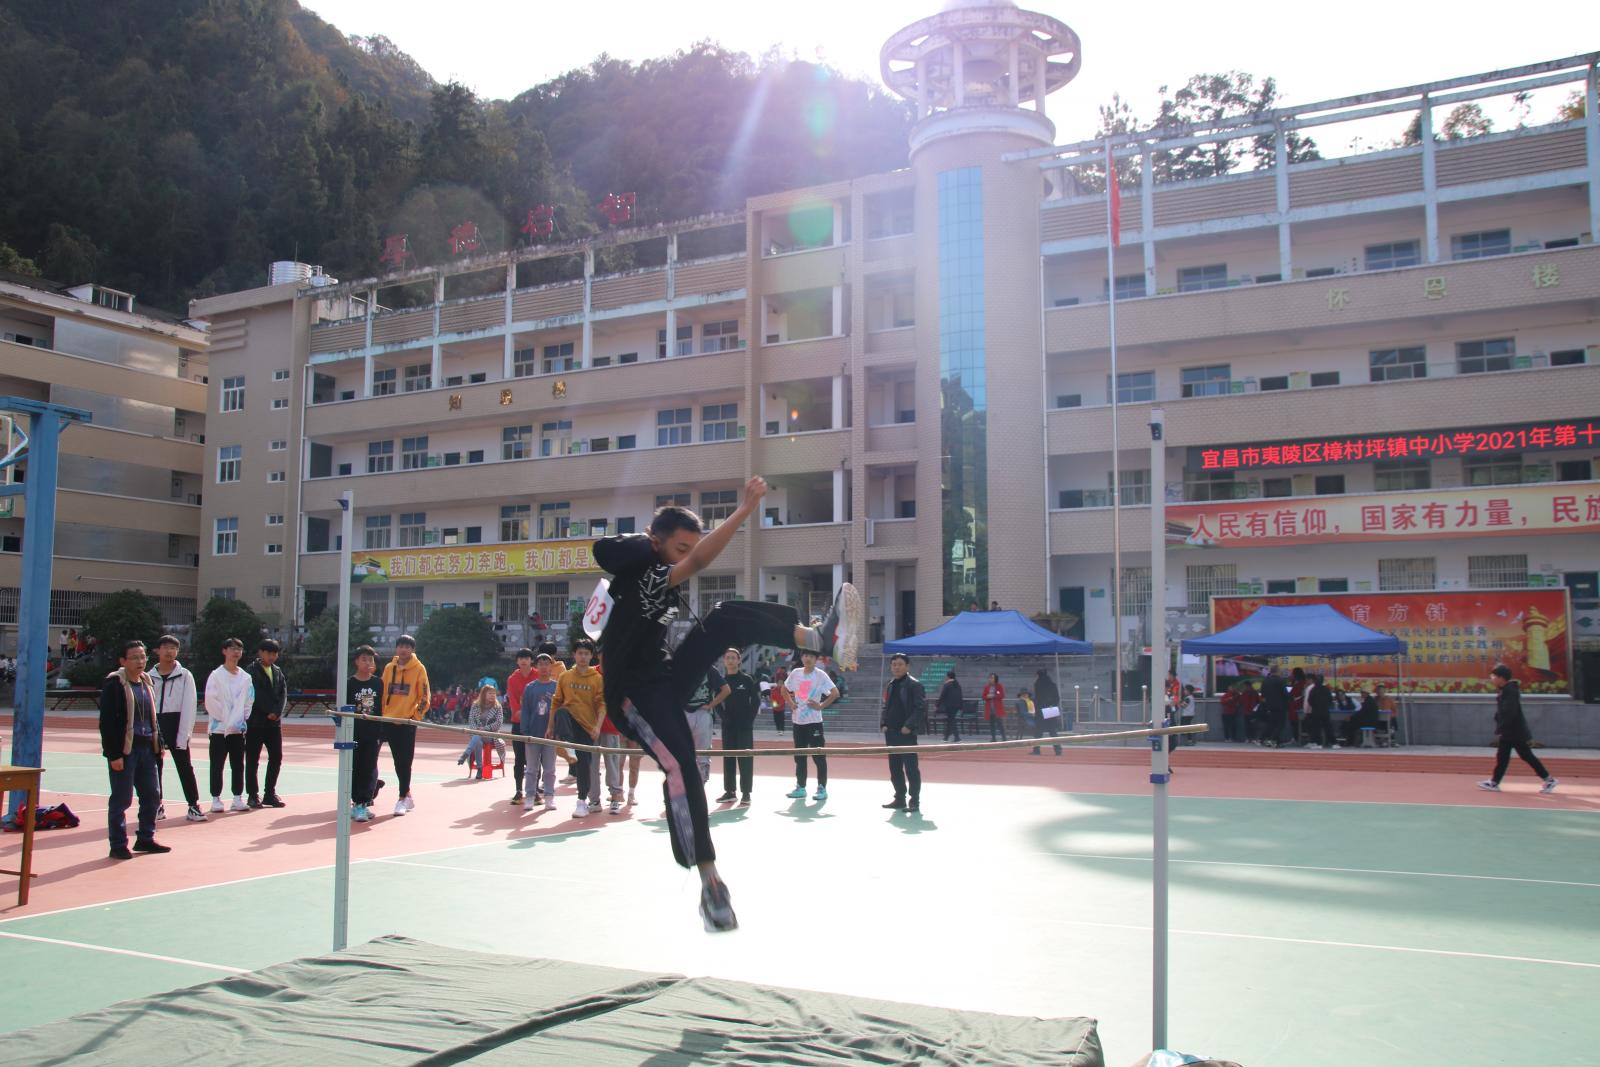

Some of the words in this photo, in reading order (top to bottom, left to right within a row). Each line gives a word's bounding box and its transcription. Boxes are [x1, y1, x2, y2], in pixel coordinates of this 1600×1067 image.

[1326, 263, 1561, 312] 怀恩楼
[1201, 423, 1600, 469] 宜昌市夷陵区樟村坪镇中小学2021年第十
[390, 546, 602, 577] 我们都在努力奔跑，我们都是
[1350, 603, 1448, 624] 育方针
